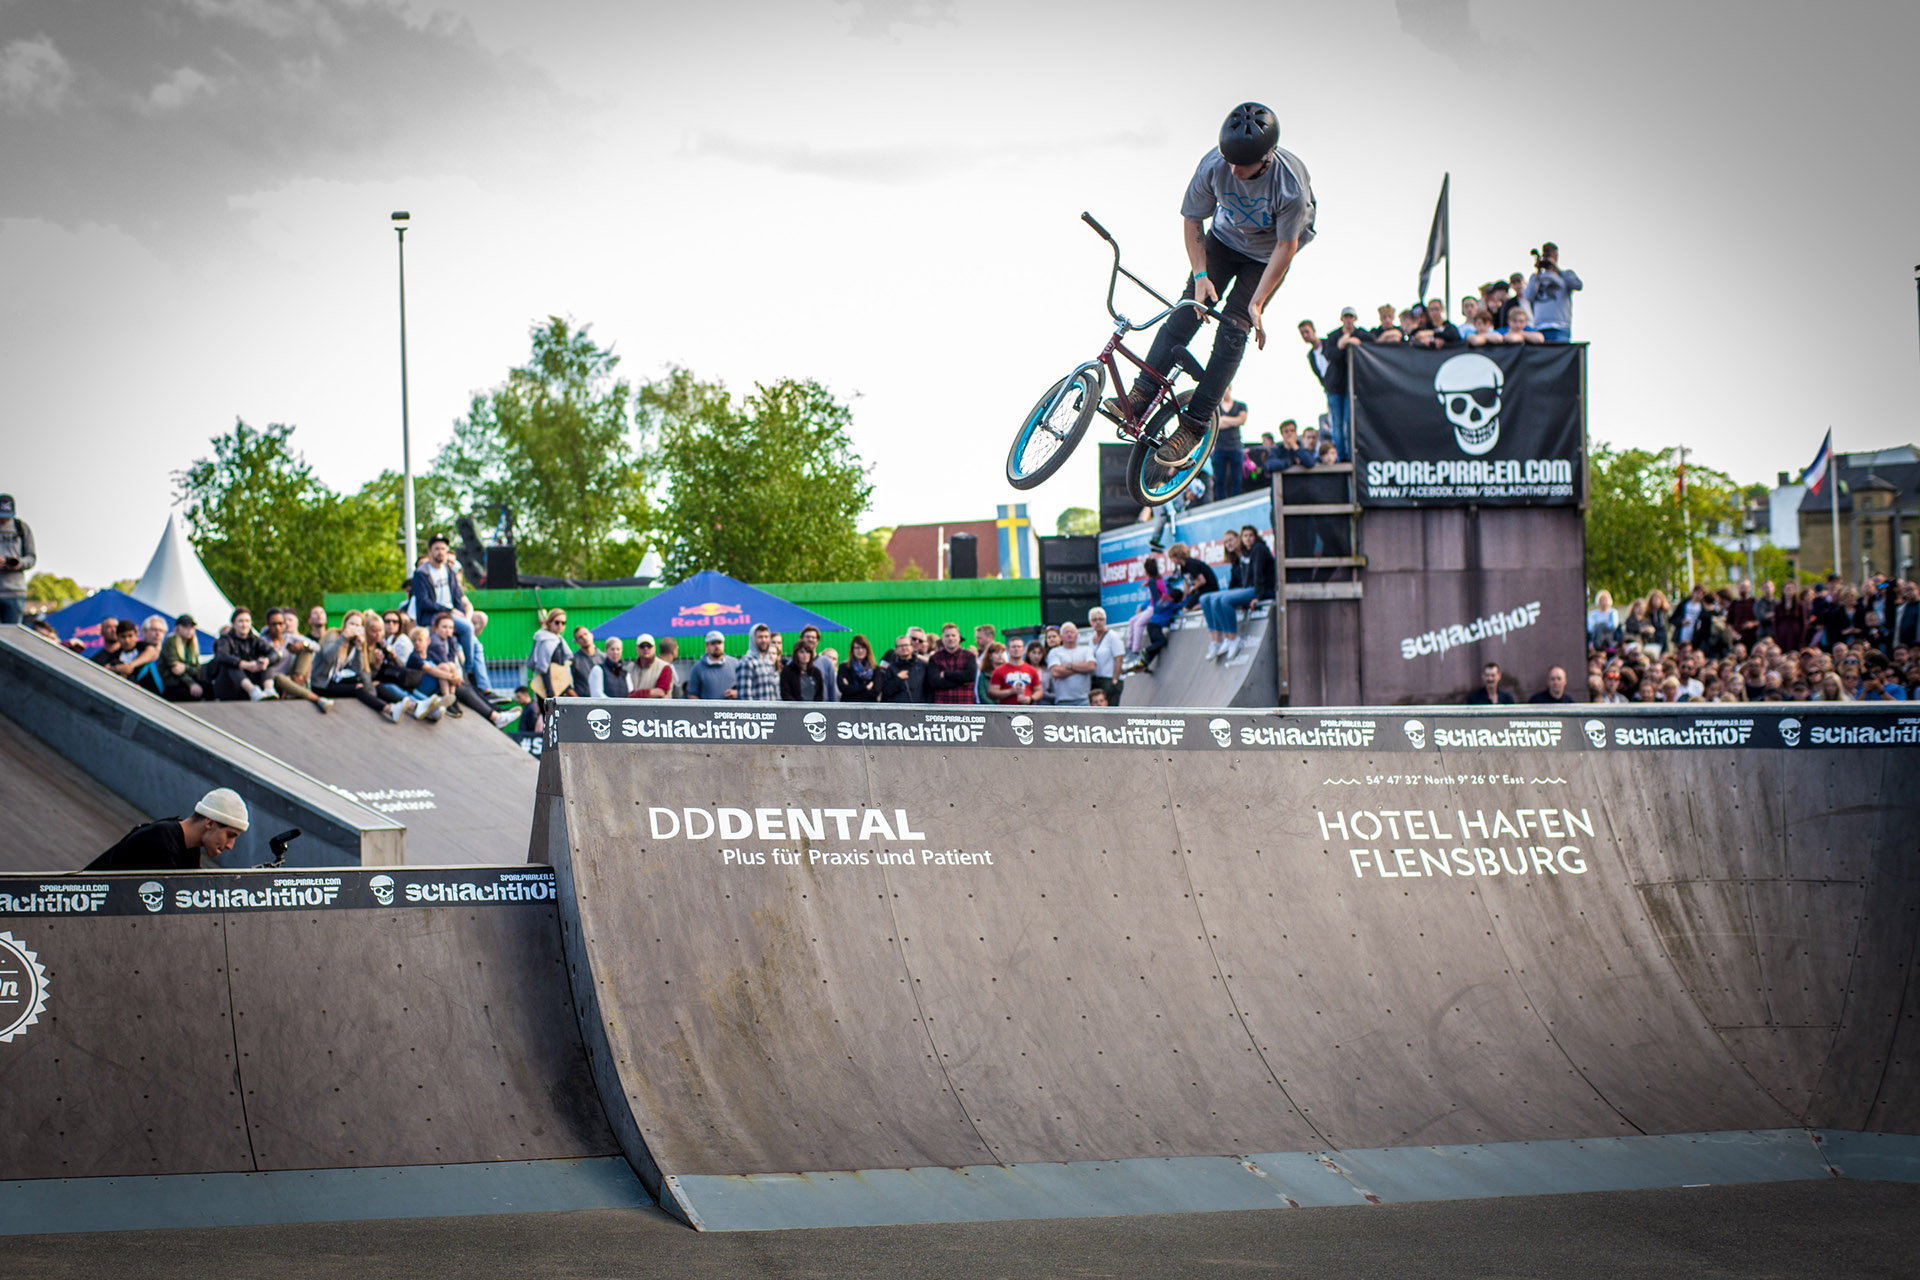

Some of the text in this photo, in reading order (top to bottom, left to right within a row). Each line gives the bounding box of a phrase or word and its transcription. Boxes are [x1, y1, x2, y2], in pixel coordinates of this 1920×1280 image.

[671, 614, 751, 627] Red Bull
[1424, 775, 1455, 785] North
[1502, 774, 1525, 785] East
[648, 807, 926, 840] DDDENTAL
[1317, 808, 1595, 841] HOTEL HAFEN
[722, 848, 994, 866] Plus für Praxis und Patient
[1350, 845, 1588, 878] FLENSBURG
